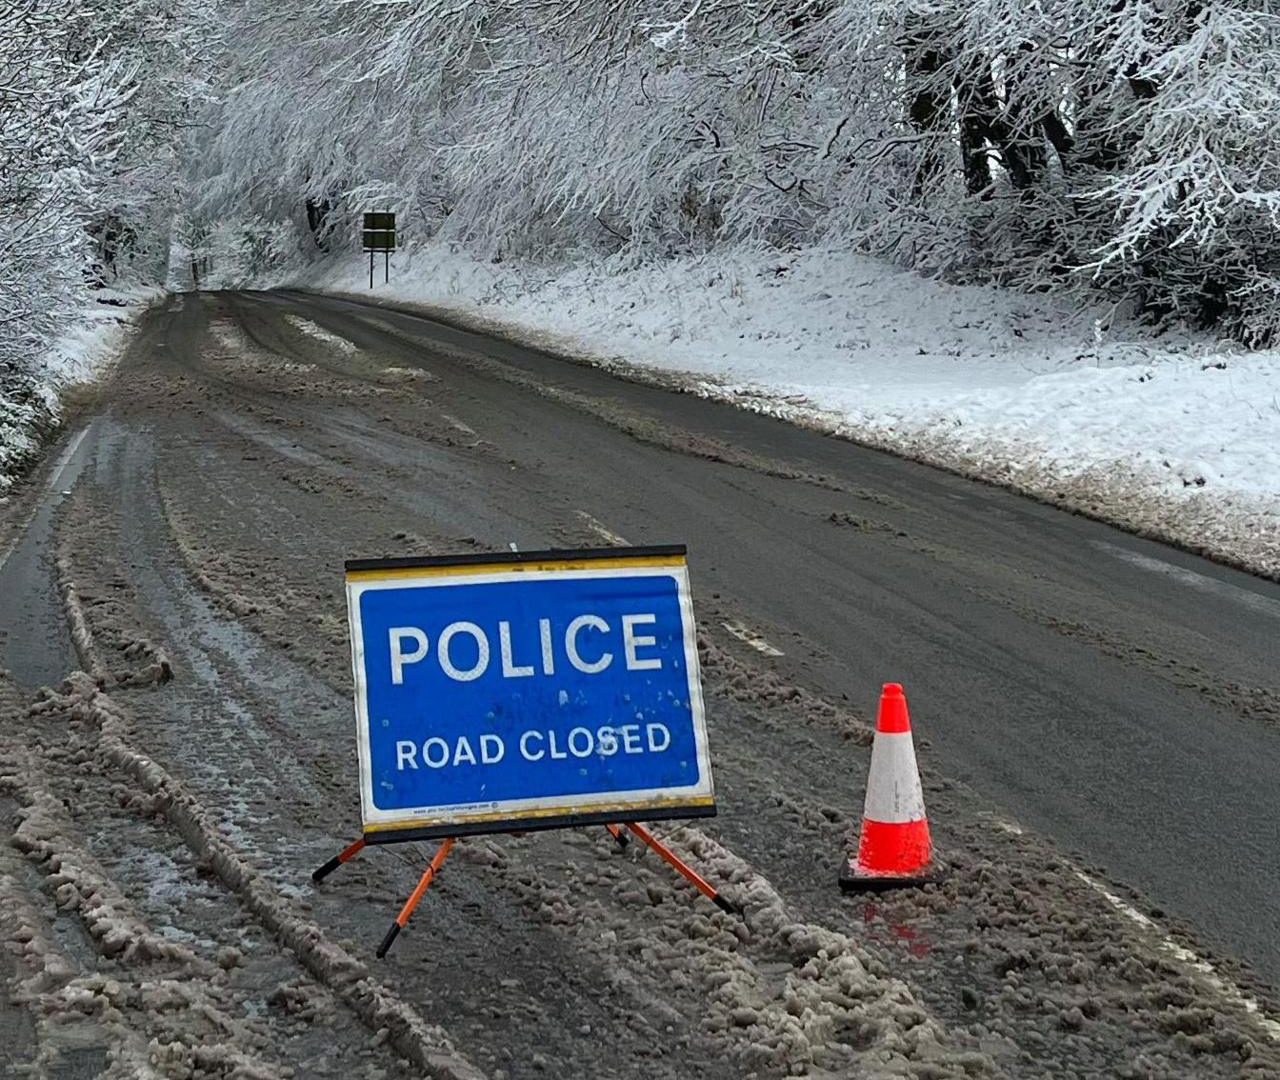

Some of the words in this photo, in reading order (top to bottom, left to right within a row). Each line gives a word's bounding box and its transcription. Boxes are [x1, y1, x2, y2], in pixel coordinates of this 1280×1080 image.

[388, 613, 662, 685] POLICE
[395, 734, 505, 770] ROAD
[519, 723, 671, 761] CLOSED
